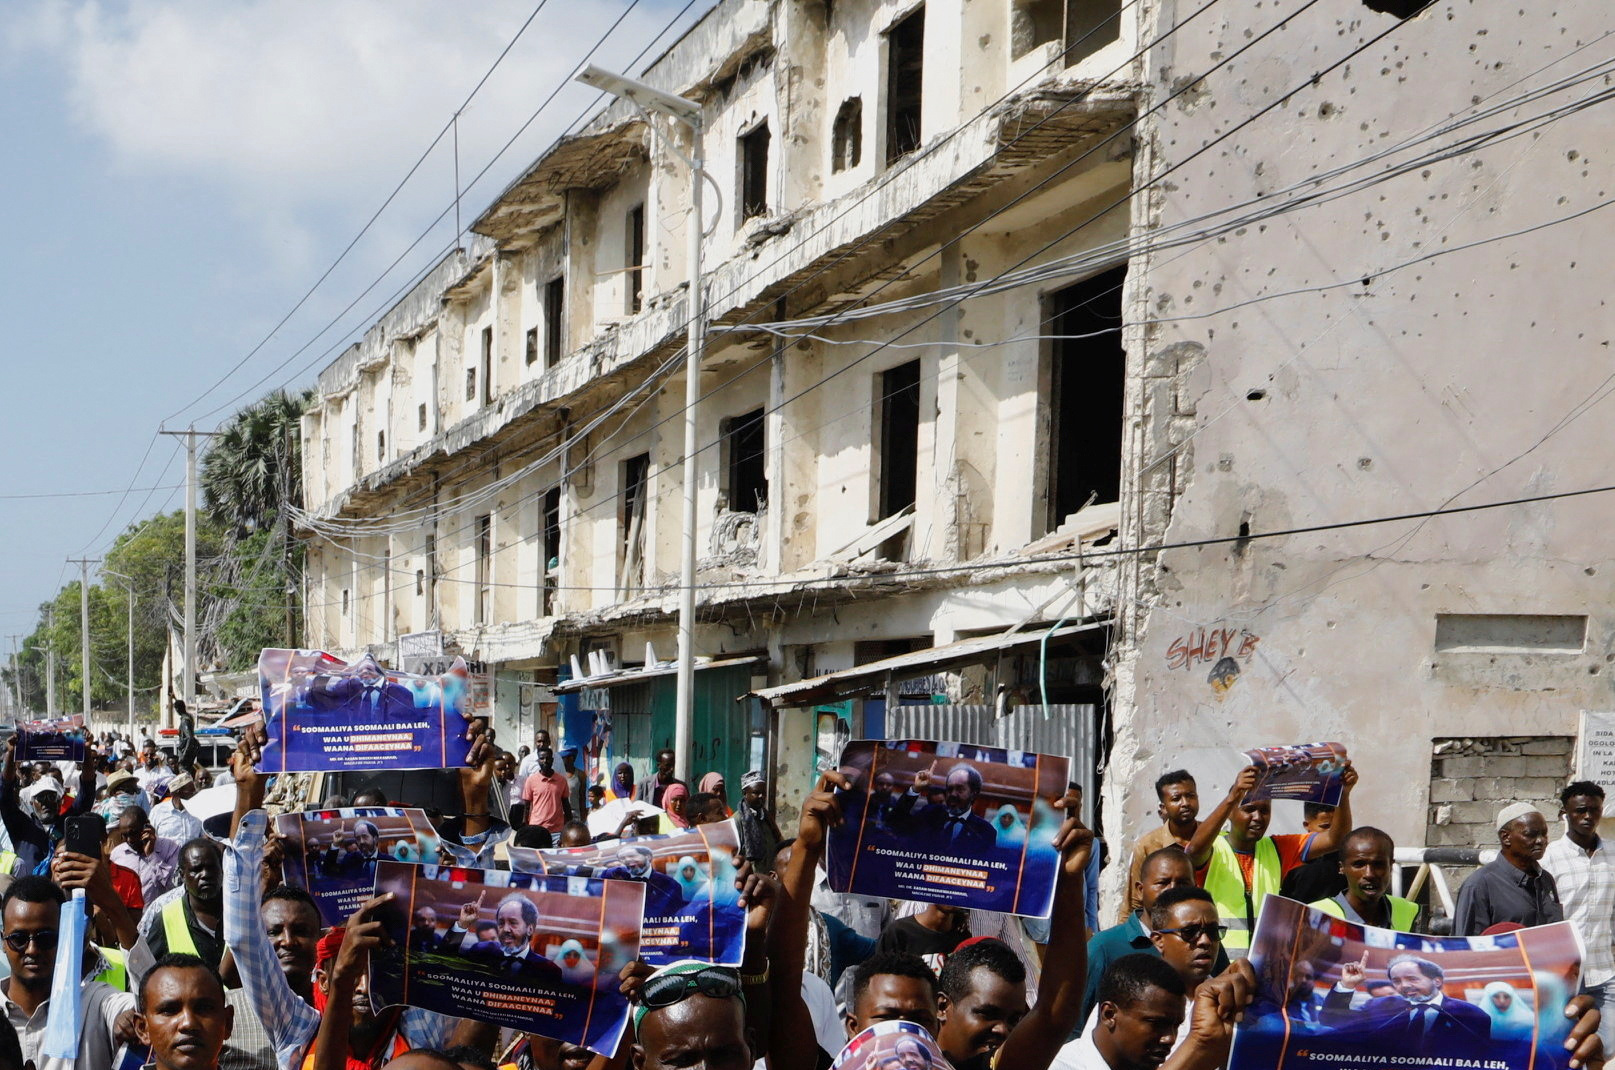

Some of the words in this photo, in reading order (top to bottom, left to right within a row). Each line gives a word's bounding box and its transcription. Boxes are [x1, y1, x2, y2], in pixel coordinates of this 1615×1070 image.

[1165, 627, 1236, 671] SHEY
[301, 725, 352, 733] SOOMAALIYA
[354, 723, 394, 731] SOOMAALI
[396, 722, 413, 730] BAA
[324, 744, 354, 752] WAANA
[876, 848, 928, 860] SOOMAALIYA
[929, 854, 971, 865] SOOMAALI
[972, 859, 989, 867] BAA
[991, 862, 1008, 871] LEH,
[894, 871, 925, 880] WAANA
[896, 861, 915, 869] WAA
[922, 865, 987, 879] DHIMANEYNAA,
[427, 973, 486, 988] SOOMAALIYA
[488, 983, 536, 994] SOOMAALI
[451, 986, 473, 995] WAA
[483, 991, 555, 1006] DHIMANEYNAA,
[451, 993, 486, 1005] WAANA
[487, 1001, 553, 1015] DIFAACEYNAA
[1309, 1052, 1387, 1064] SOOMAALIYA
[1390, 1056, 1453, 1067] SOOMAALI
[1455, 1059, 1481, 1068] BAA
